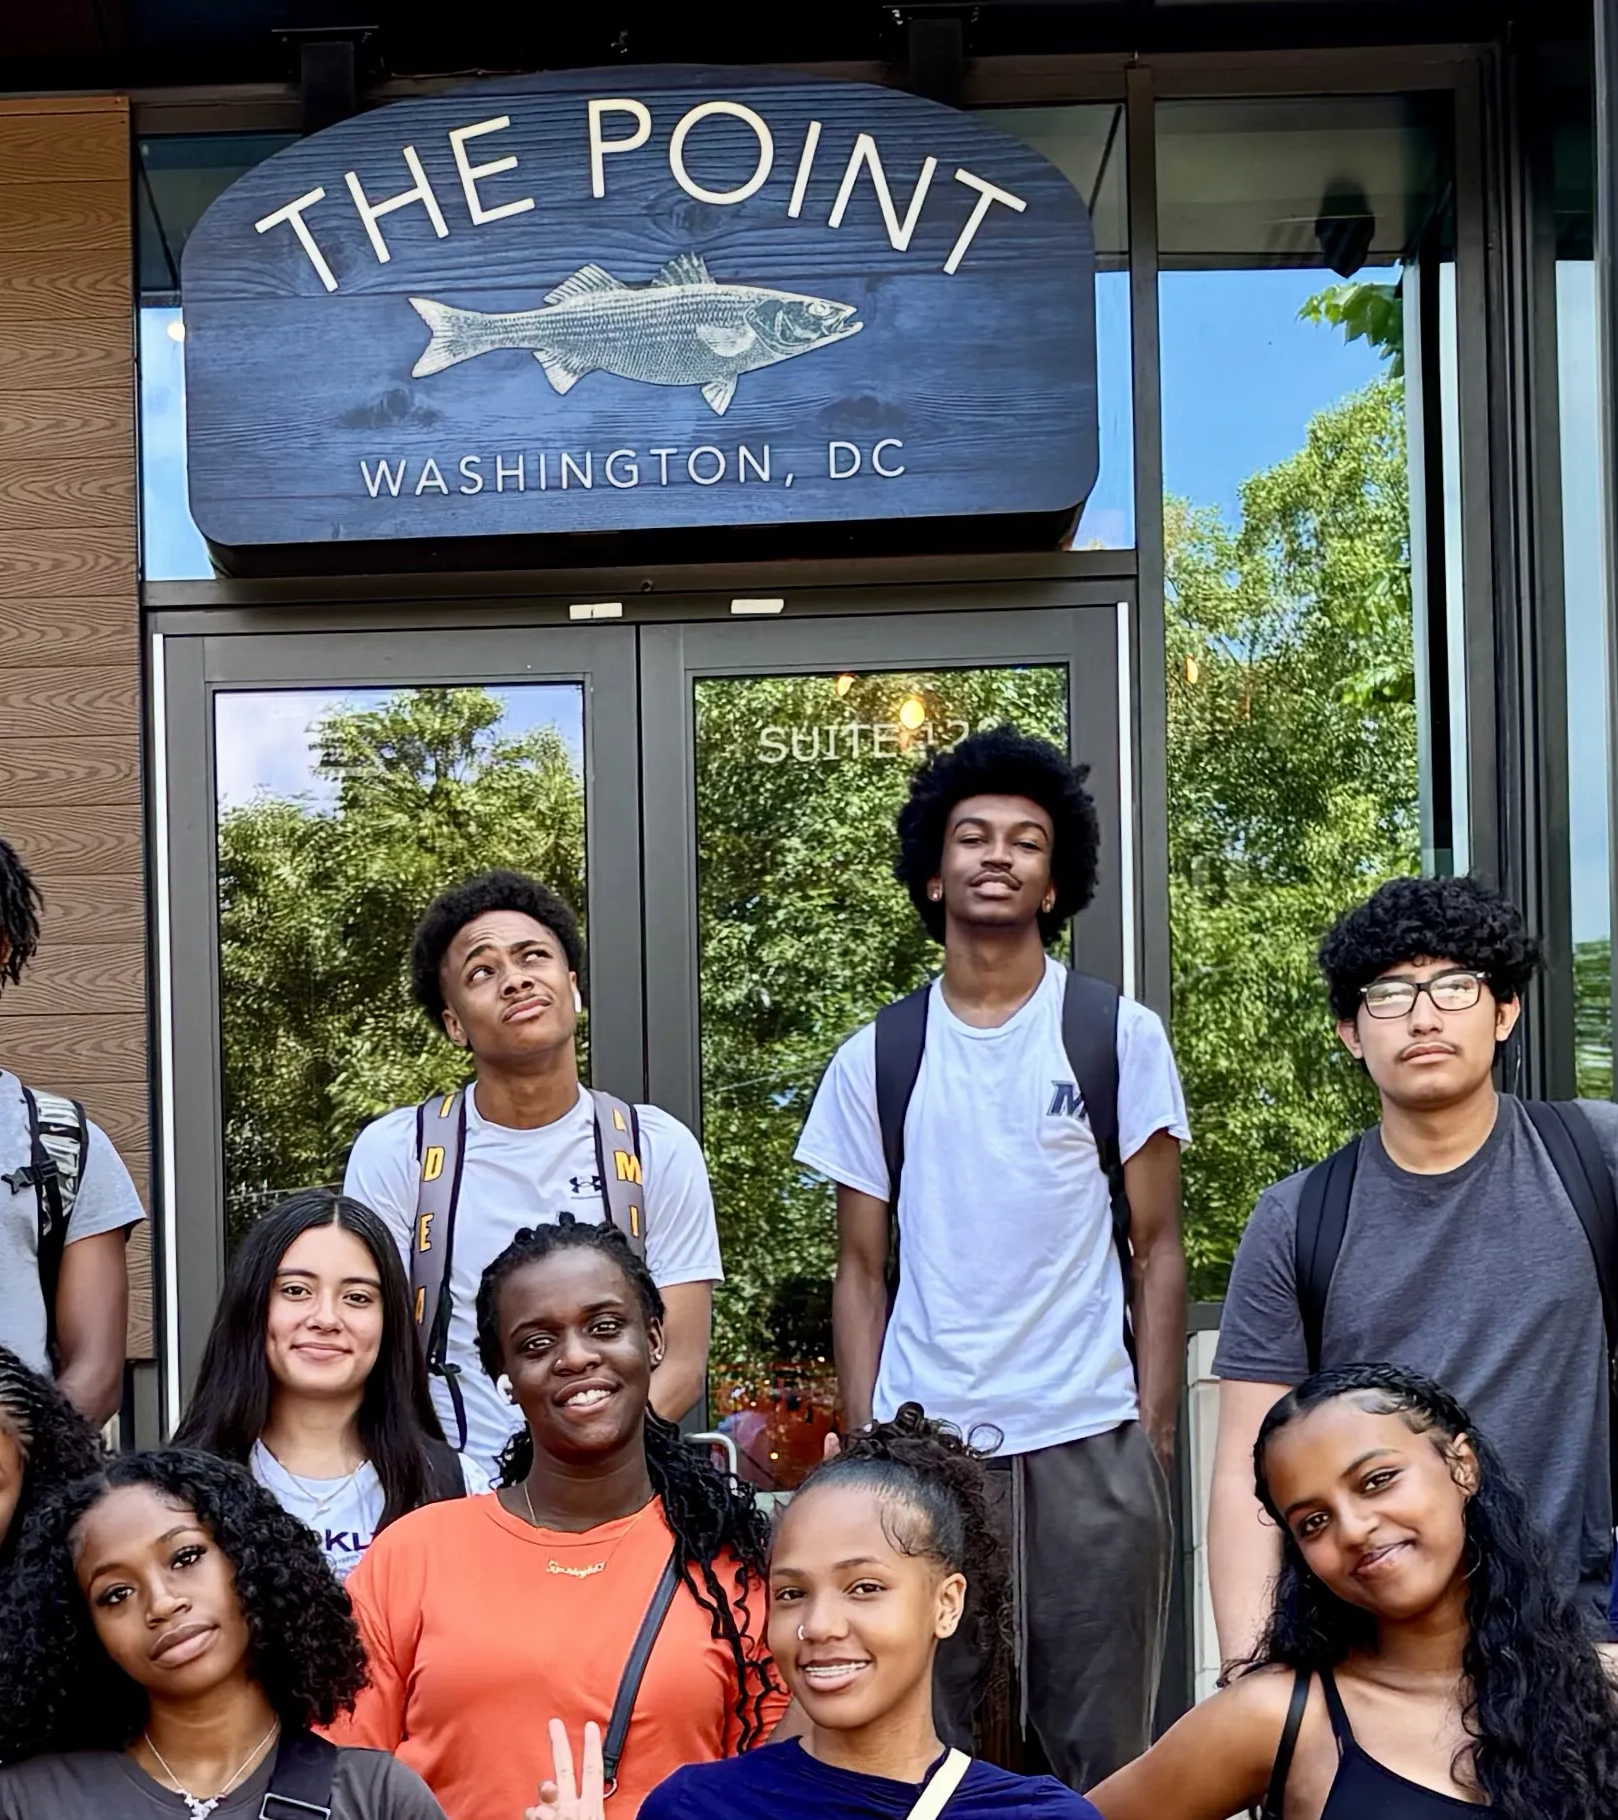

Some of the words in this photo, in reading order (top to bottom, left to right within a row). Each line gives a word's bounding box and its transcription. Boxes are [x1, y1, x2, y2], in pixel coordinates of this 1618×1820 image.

[255, 115, 534, 292] THE
[588, 98, 1026, 275] POINT
[360, 443, 794, 499] WASHINGTON,
[828, 438, 906, 480] DC
[758, 721, 899, 763] SUITE
